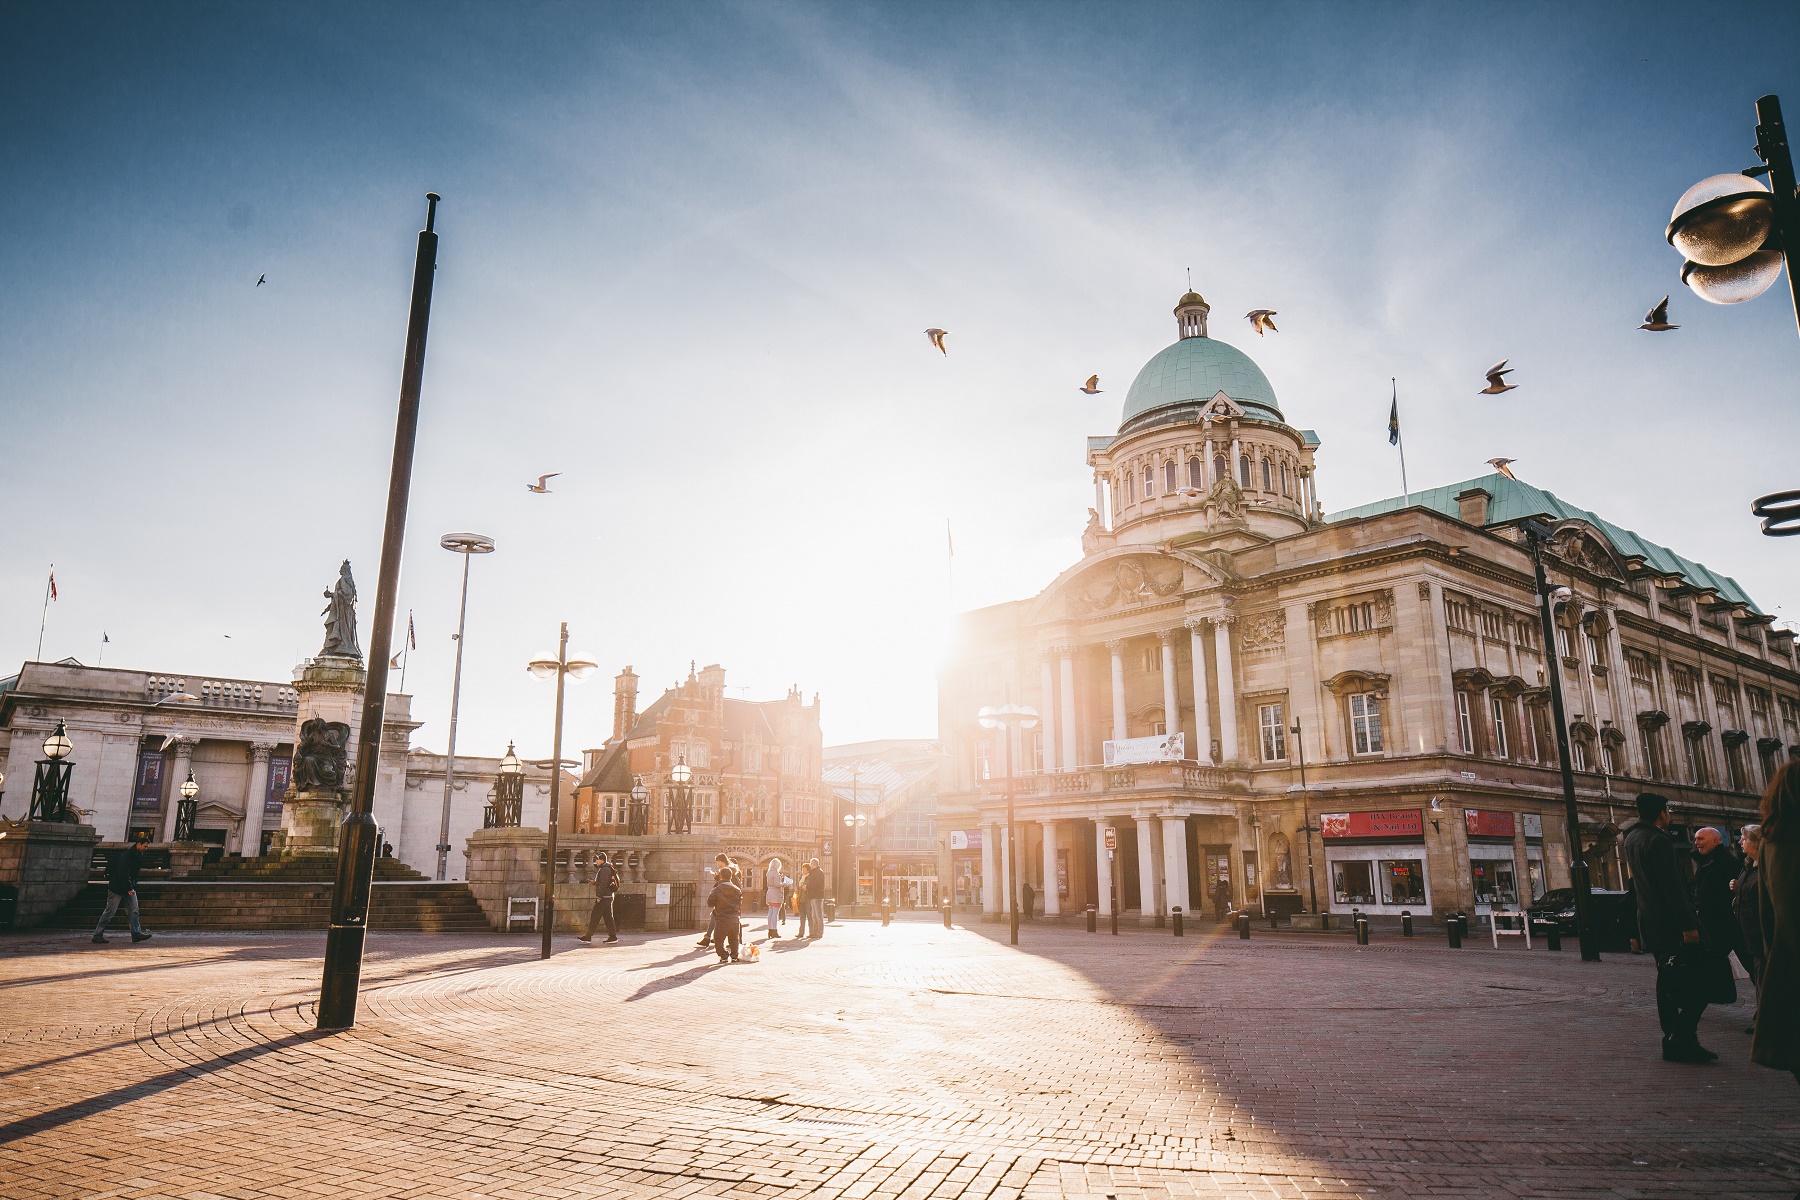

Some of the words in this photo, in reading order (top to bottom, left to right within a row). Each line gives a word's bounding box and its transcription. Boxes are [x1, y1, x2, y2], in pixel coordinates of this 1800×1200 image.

[157, 717, 176, 726] THE
[184, 719, 224, 729] FERENS
[229, 723, 249, 731] ART
[255, 725, 296, 734] GALLERY
[1389, 812, 1419, 820] Beauty
[1402, 822, 1420, 830] Ltd.
